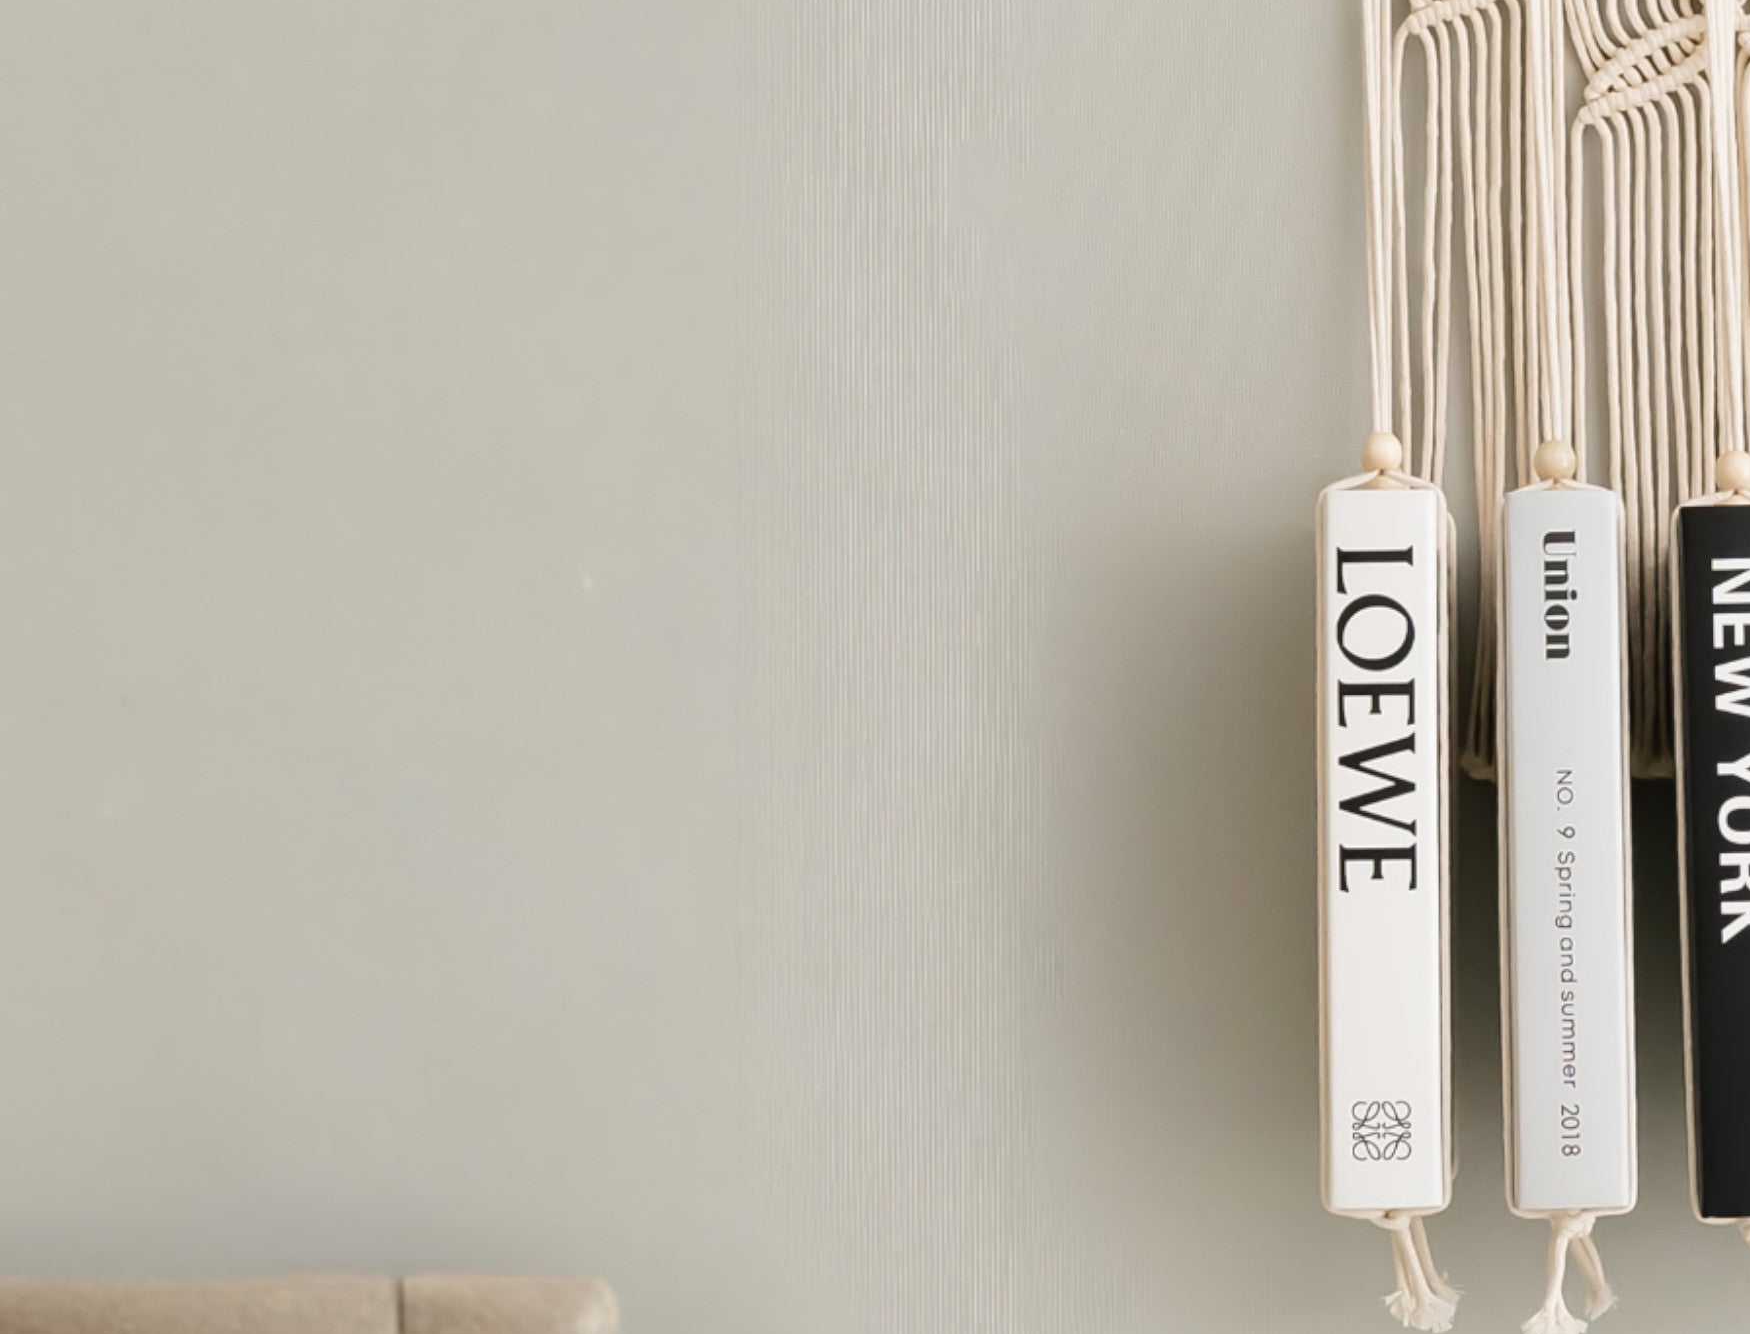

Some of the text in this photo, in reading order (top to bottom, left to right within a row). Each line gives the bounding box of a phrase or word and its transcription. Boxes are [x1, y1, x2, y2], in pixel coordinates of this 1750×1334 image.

[1335, 544, 1418, 894] LOEWE
[1542, 530, 1578, 661] Union
[1555, 769, 1582, 1157] NO. 9 Spring and summer 2018
